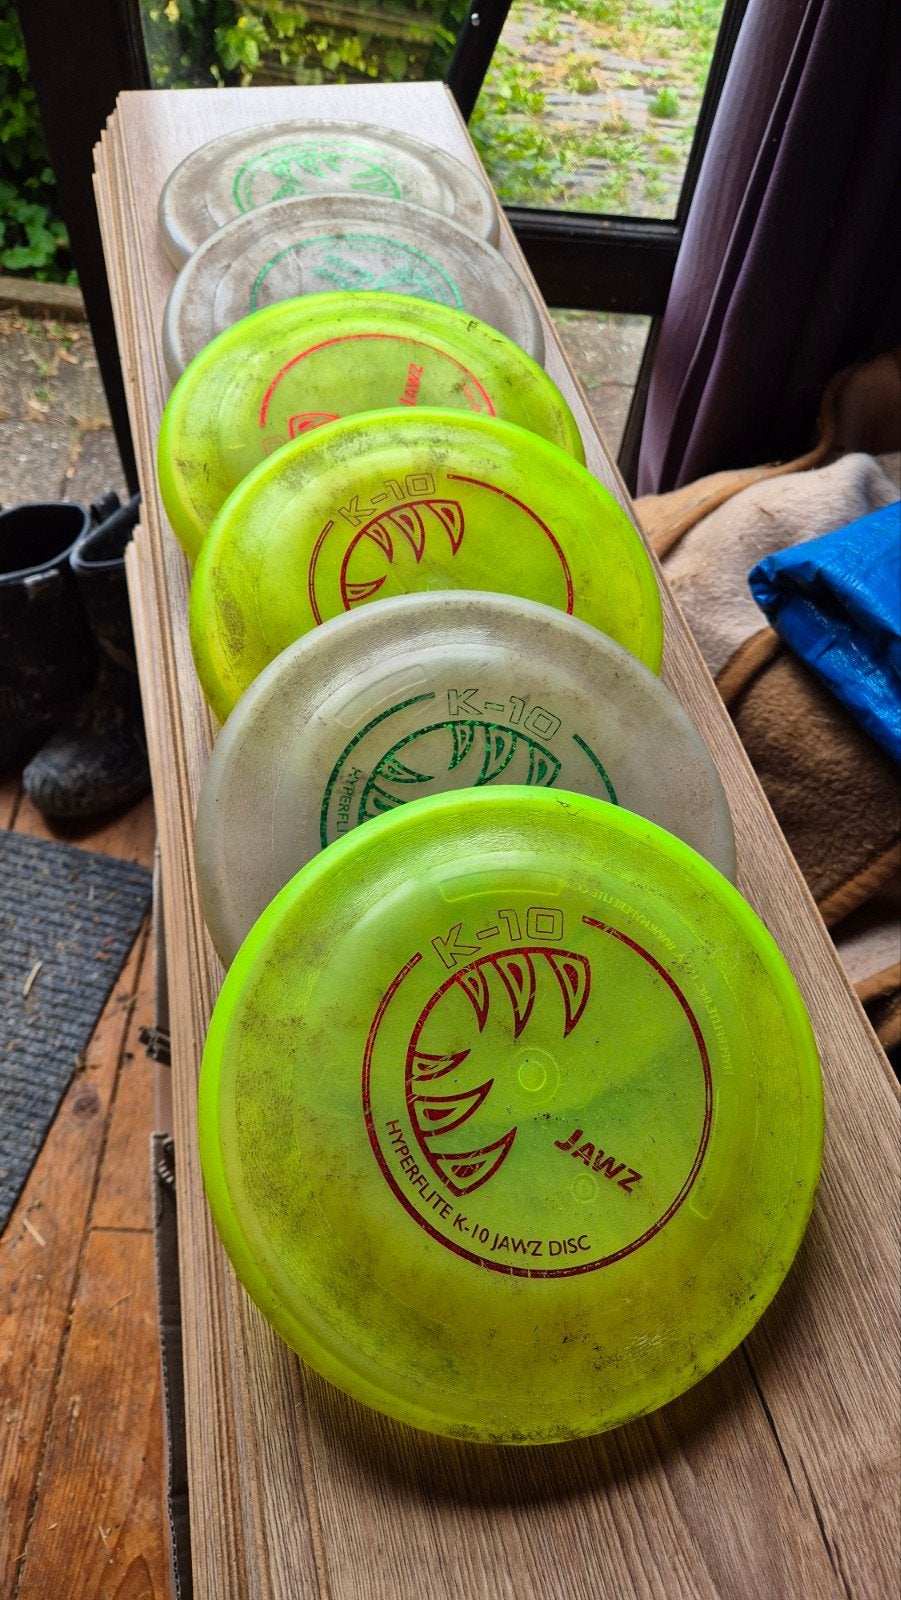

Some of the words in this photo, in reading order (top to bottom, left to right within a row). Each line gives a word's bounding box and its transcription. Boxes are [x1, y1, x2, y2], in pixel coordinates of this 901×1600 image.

[337, 473, 435, 527] K-10
[447, 688, 562, 742] K-10
[336, 766, 362, 833] HYPERFLI
[431, 906, 564, 970] K-10
[385, 1118, 454, 1220] HYPERFLITE
[452, 1213, 490, 1244] K-10
[490, 1233, 543, 1257] JAWZ
[548, 1234, 591, 1257] DISC
[554, 1128, 643, 1194] JAWZ
